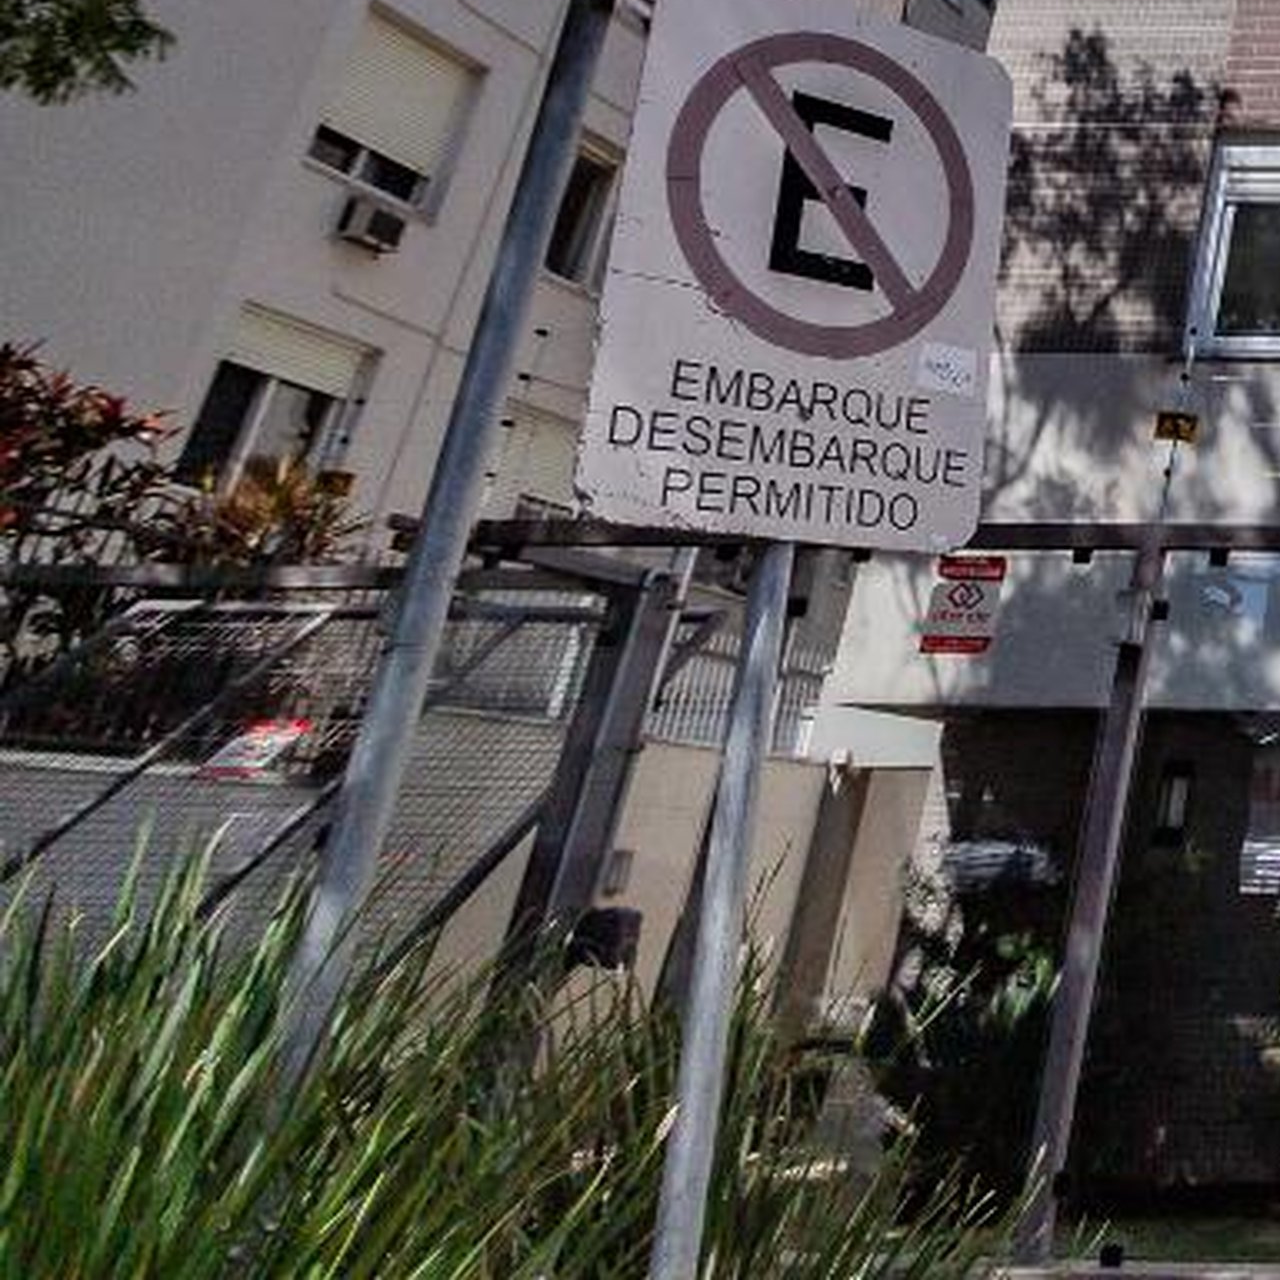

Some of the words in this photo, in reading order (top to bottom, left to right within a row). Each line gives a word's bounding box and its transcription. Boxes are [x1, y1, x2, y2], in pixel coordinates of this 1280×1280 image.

[669, 358, 931, 435] EMBARQUE
[607, 405, 969, 488] DESEMBARQUE
[659, 467, 920, 531] PERMITIDO
